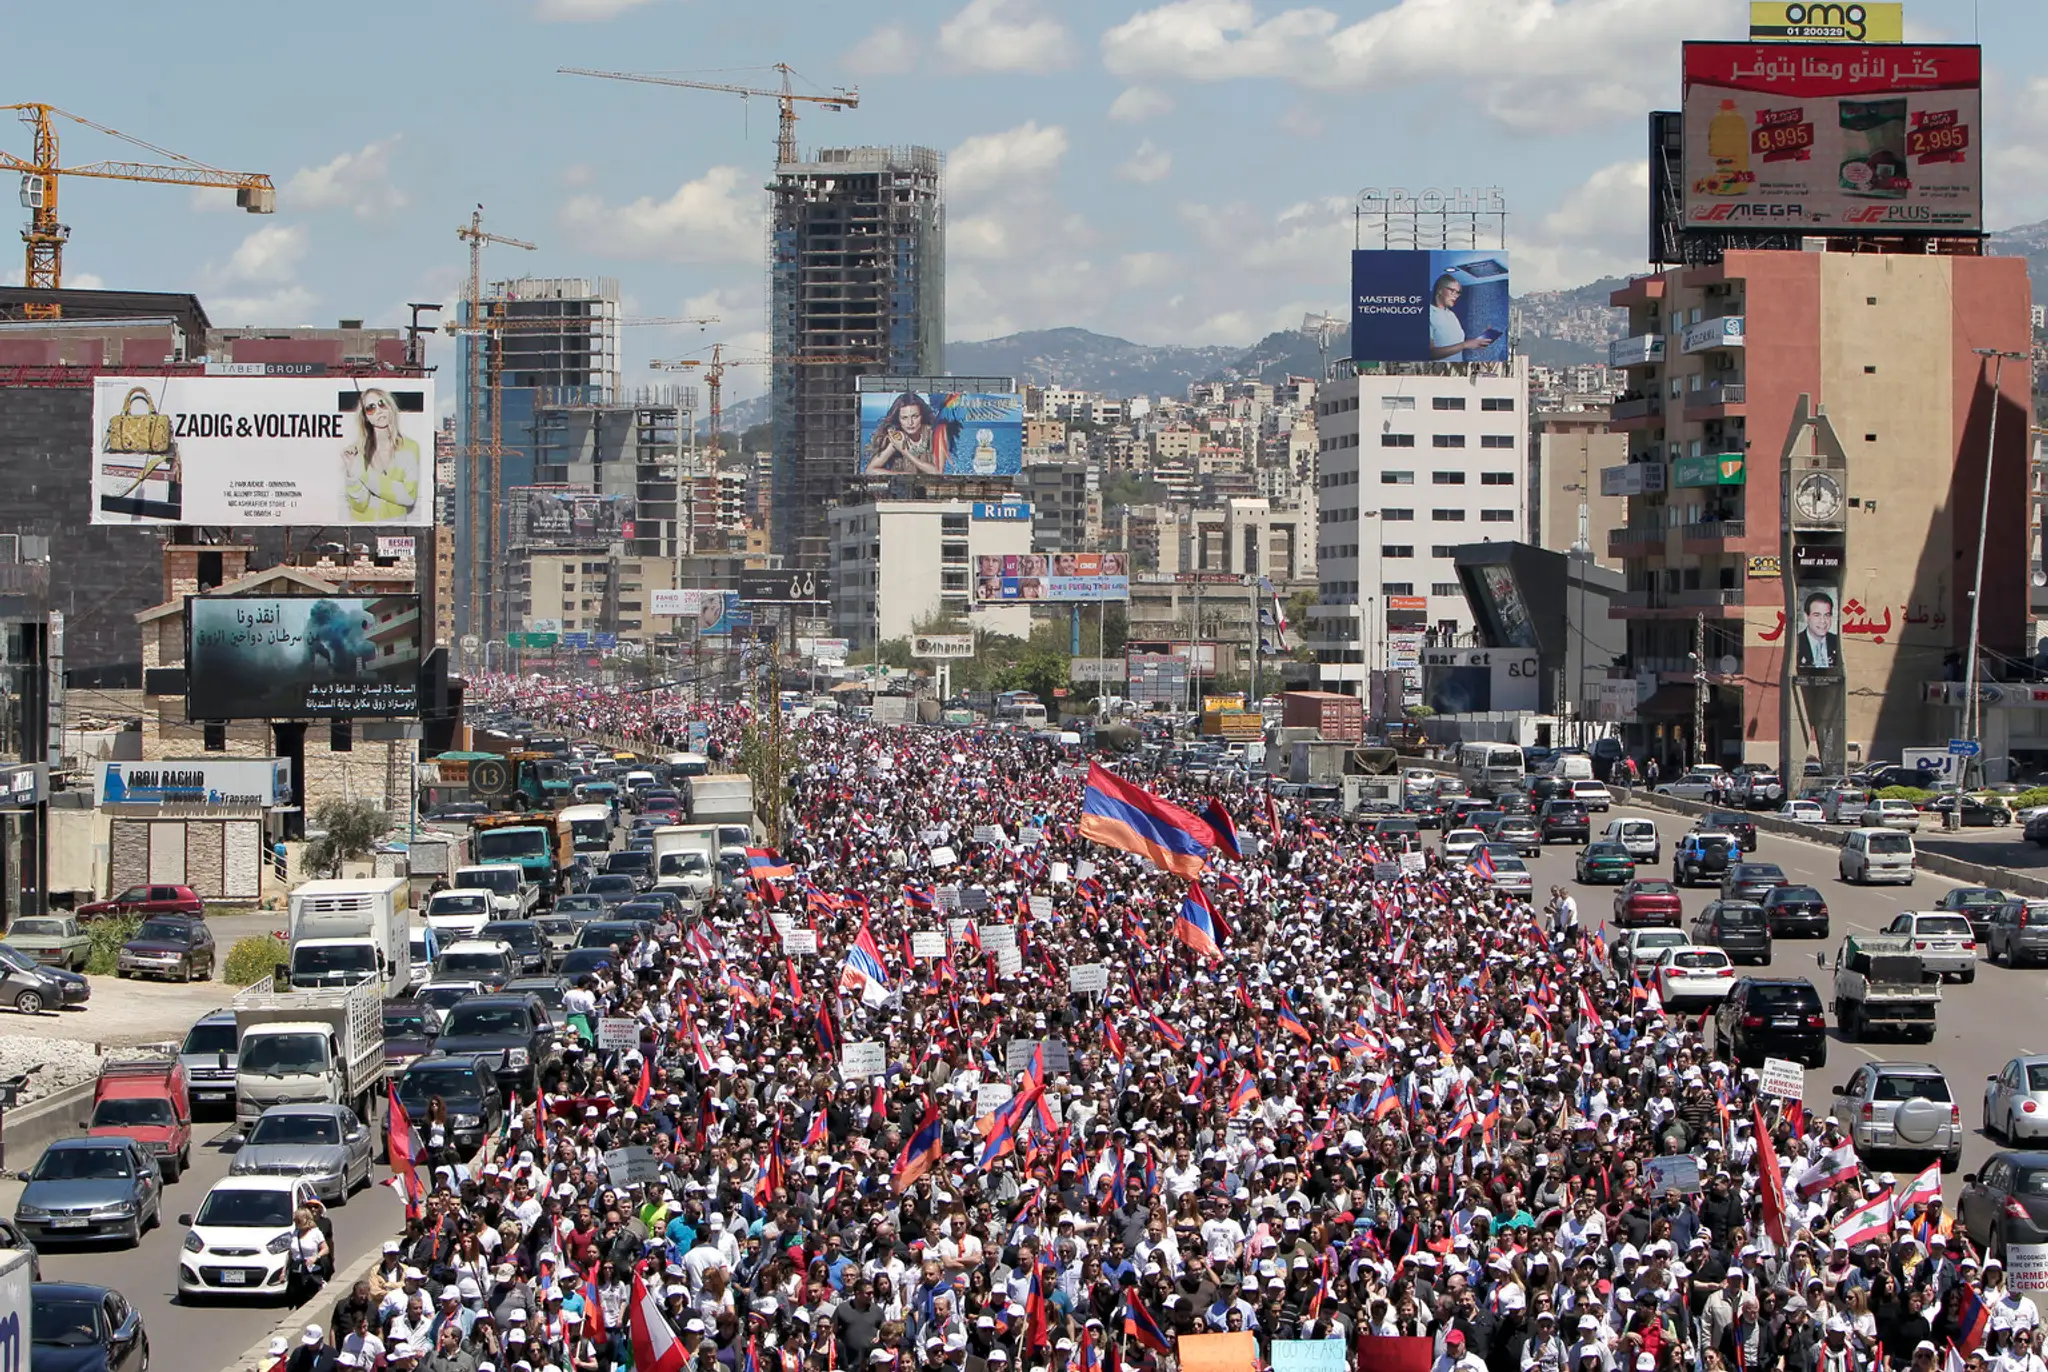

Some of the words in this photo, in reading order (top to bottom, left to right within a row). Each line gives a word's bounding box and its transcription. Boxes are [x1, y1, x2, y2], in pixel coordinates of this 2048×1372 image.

[1786, 3, 1866, 40] omg
[1787, 26, 1799, 36] 01
[1803, 26, 1843, 37] 200329
[1802, 57, 1843, 80] معنا
[1758, 126, 1808, 150] 8,995
[1912, 128, 1963, 151] 2,995
[1356, 186, 1505, 213] GROHE
[1727, 204, 1803, 220] MEGA
[1888, 205, 1930, 220] PLUS
[1360, 295, 1406, 304] MASTERS
[1409, 295, 1422, 304] OF
[1358, 305, 1423, 314] TECHNOLOGY
[221, 364, 262, 373] TABET
[266, 364, 313, 374] GROUP
[985, 504, 1017, 518] Rim
[237, 604, 280, 628] أنقذونا
[1900, 603, 1946, 630] بوظة
[267, 629, 303, 647] سرطان
[128, 770, 159, 787] ABOU
[480, 769, 499, 786] 13
[220, 792, 263, 807] Transport
[1304, 1341, 1344, 1360] YEARS
